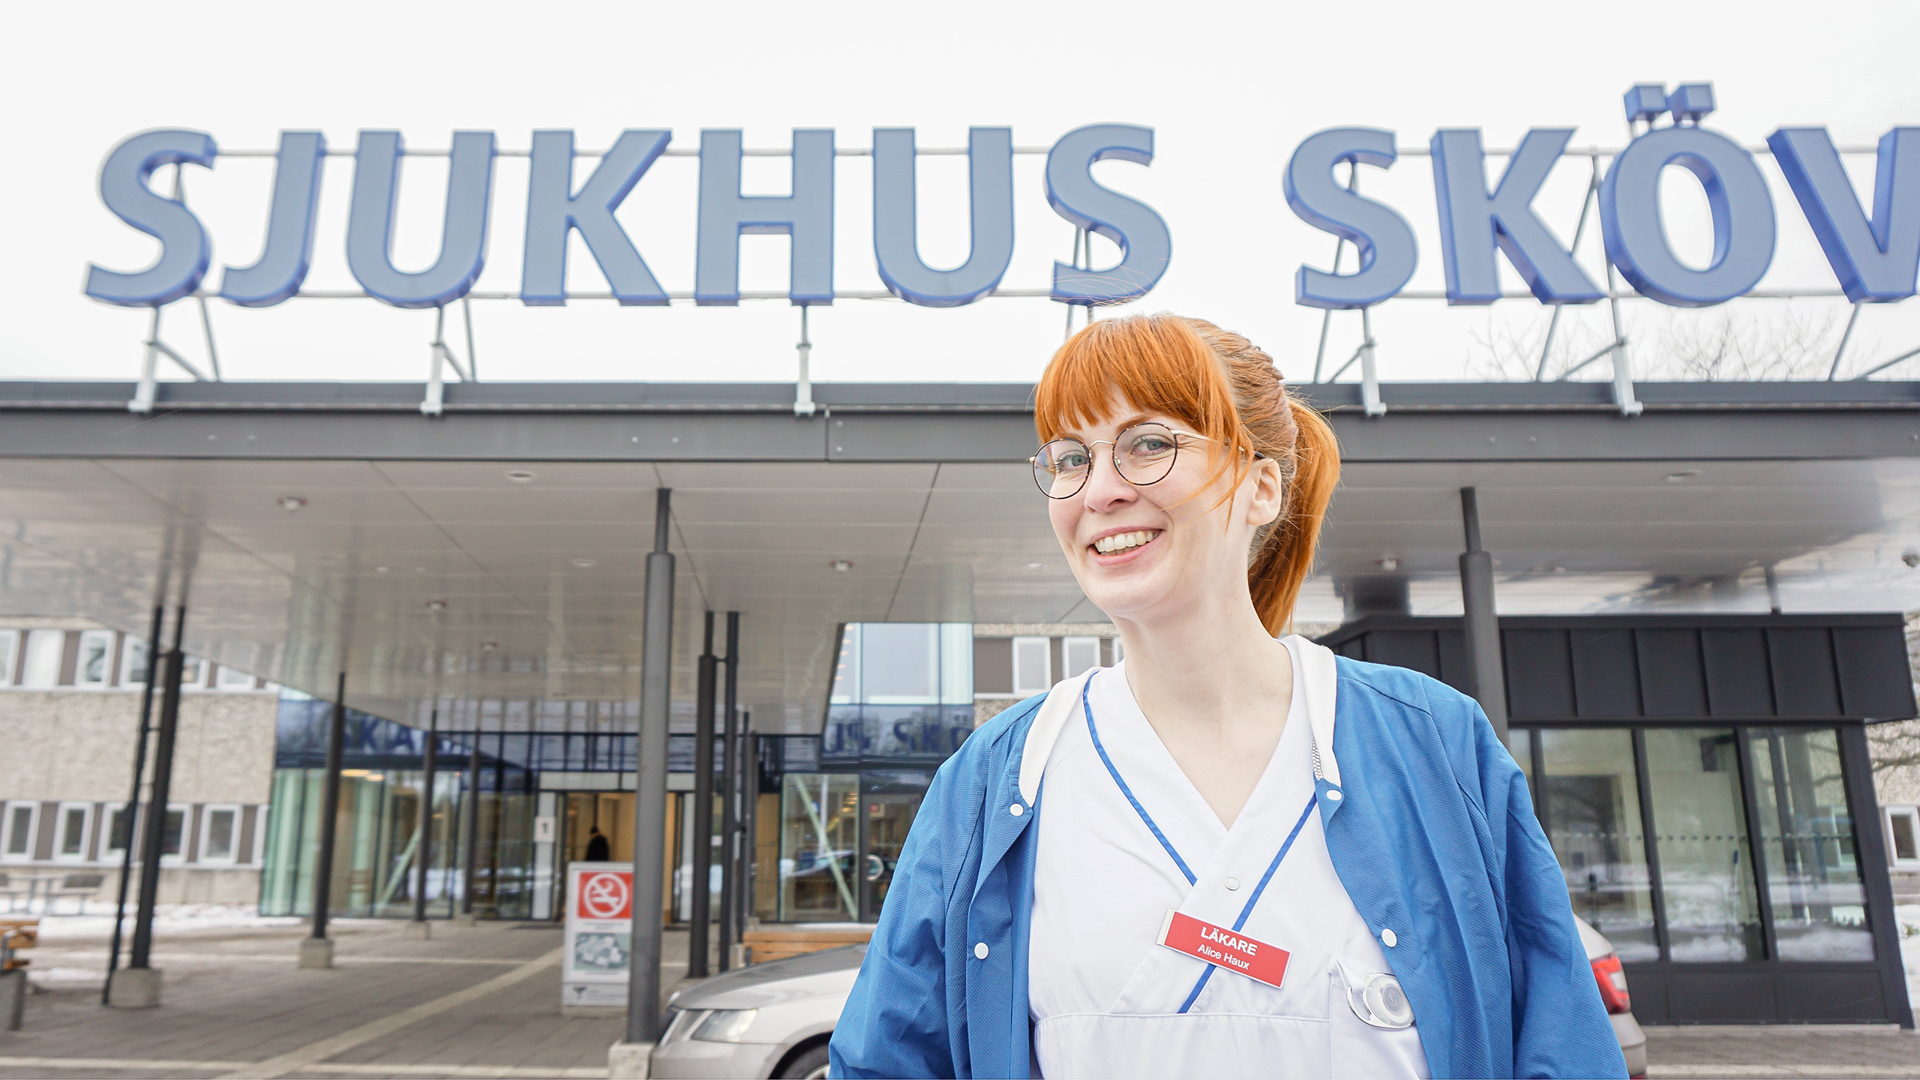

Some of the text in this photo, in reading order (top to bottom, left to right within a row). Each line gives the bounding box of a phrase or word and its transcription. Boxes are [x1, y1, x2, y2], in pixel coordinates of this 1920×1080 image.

[84, 82, 1920, 308] SJUKHUS SKÖV
[1200, 926, 1258, 956] LÄKARE
[1197, 944, 1251, 970] Alice Haux
